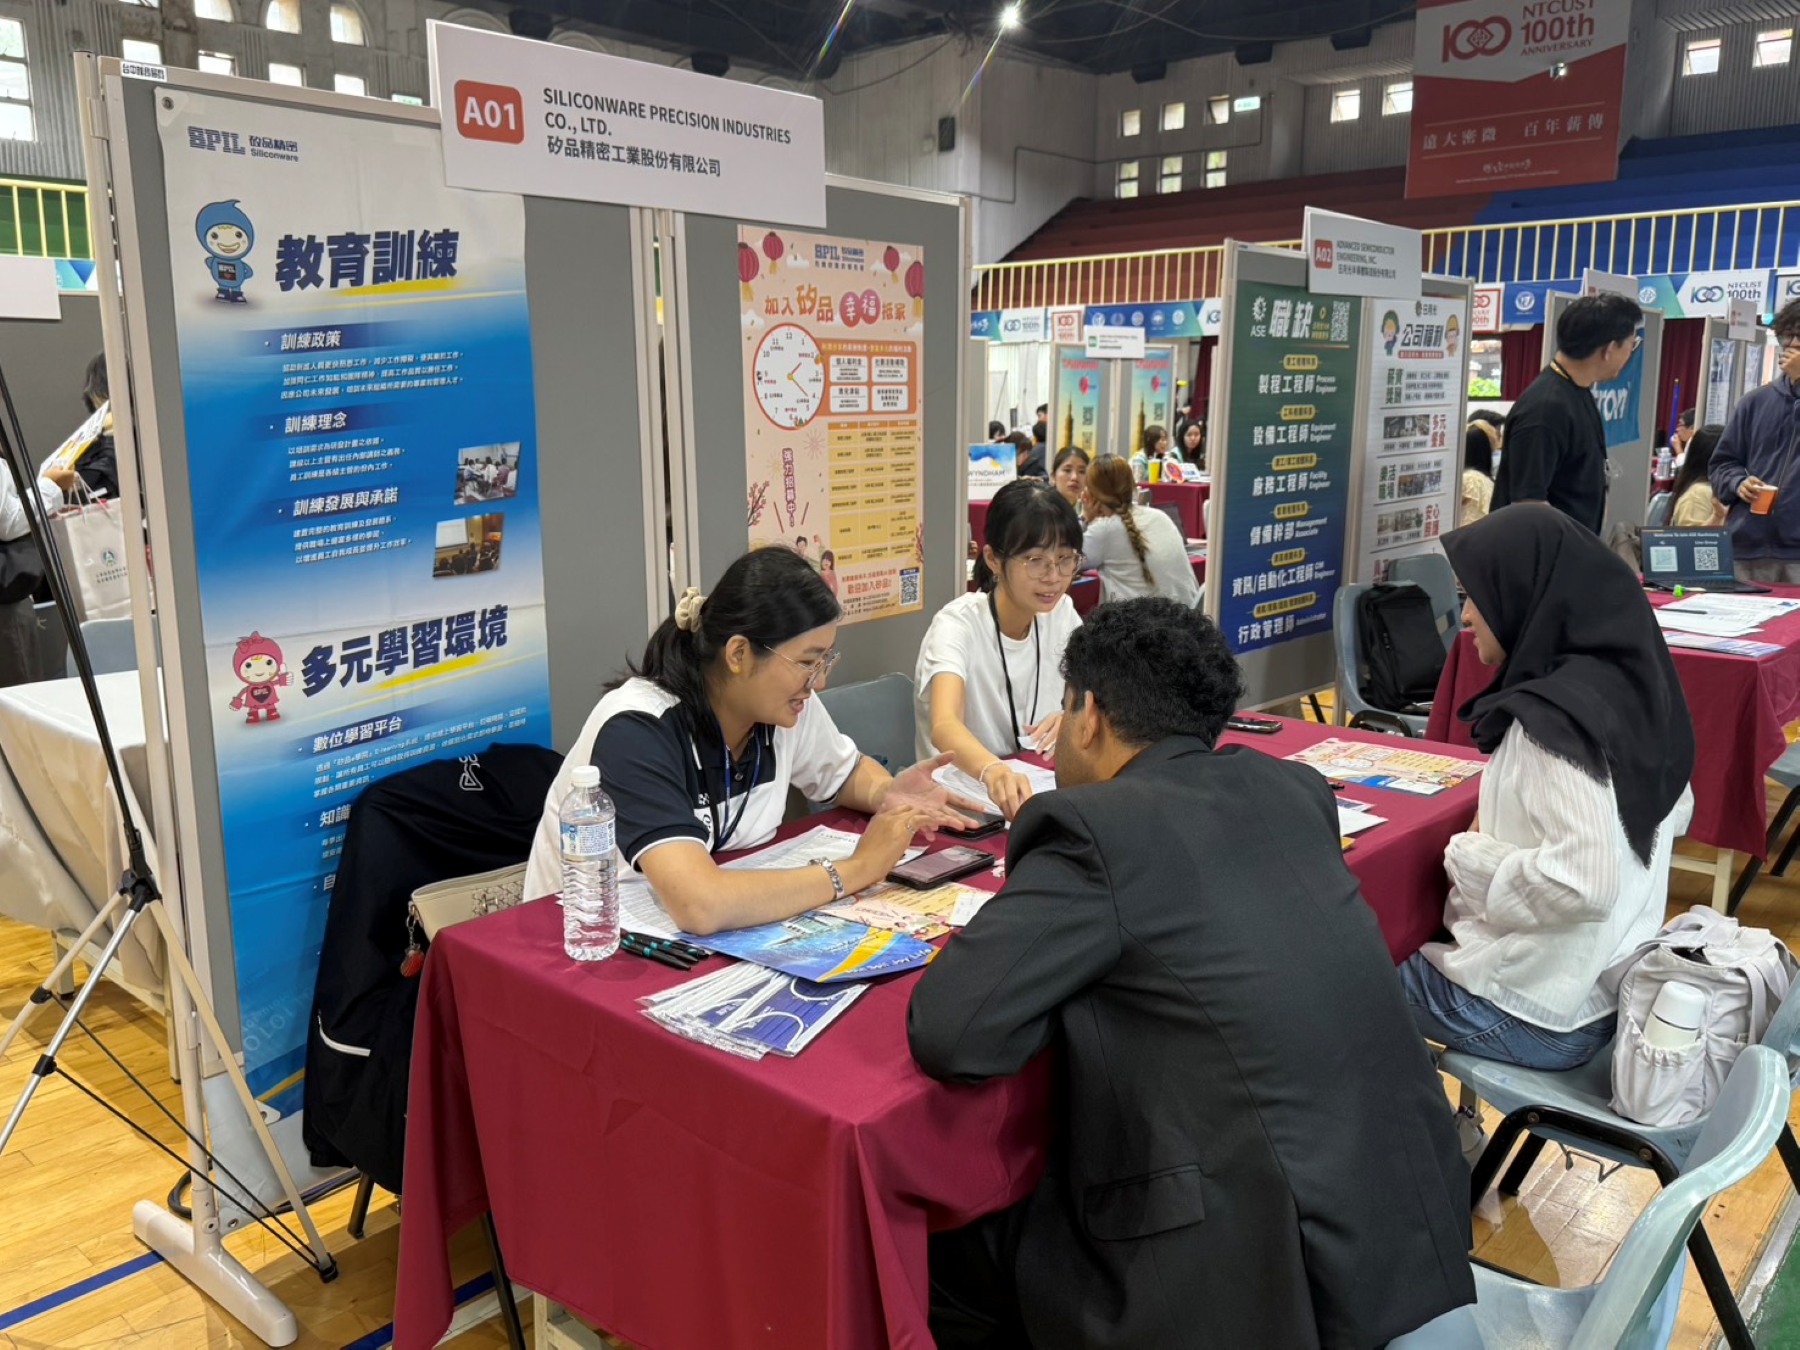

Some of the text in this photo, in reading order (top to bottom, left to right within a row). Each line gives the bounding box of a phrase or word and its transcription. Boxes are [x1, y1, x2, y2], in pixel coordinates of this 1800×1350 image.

[1522, 0, 1595, 19] NTCUST
[1521, 14, 1595, 45] 100th
[1520, 39, 1594, 56] ANNIVERSARY
[462, 96, 518, 131] A01
[543, 87, 792, 145] SILICONWARE PRECISION INDUSTRIES
[544, 111, 612, 137] CO., LTD.
[250, 148, 299, 162] Siliconware
[547, 134, 722, 177] 矽品精密工業股份有限公司
[275, 228, 459, 292] 教育訓練
[1315, 245, 1332, 263] A02
[1727, 288, 1761, 299] 100th
[1728, 280, 1762, 289] NTCUST
[764, 283, 834, 322] 加入矽品
[1250, 325, 1267, 338] ASE
[1269, 299, 1314, 338] 職缺
[280, 330, 342, 351] 訓練政策
[1402, 323, 1444, 349] 公司福利
[1257, 374, 1317, 394] 製程工程師
[284, 411, 347, 434] 訓練理念
[1253, 423, 1310, 446] 設備工程師
[1252, 472, 1308, 496] 廠務工程師
[293, 487, 398, 517] 訓練發展與承諾
[1250, 521, 1296, 546] 儲備幹部
[1232, 562, 1316, 598] 資訊/自動化工程師
[1238, 613, 1296, 645] 行政管理師
[301, 604, 508, 698] 多元學習環境
[312, 716, 402, 754] 數位學習平台
